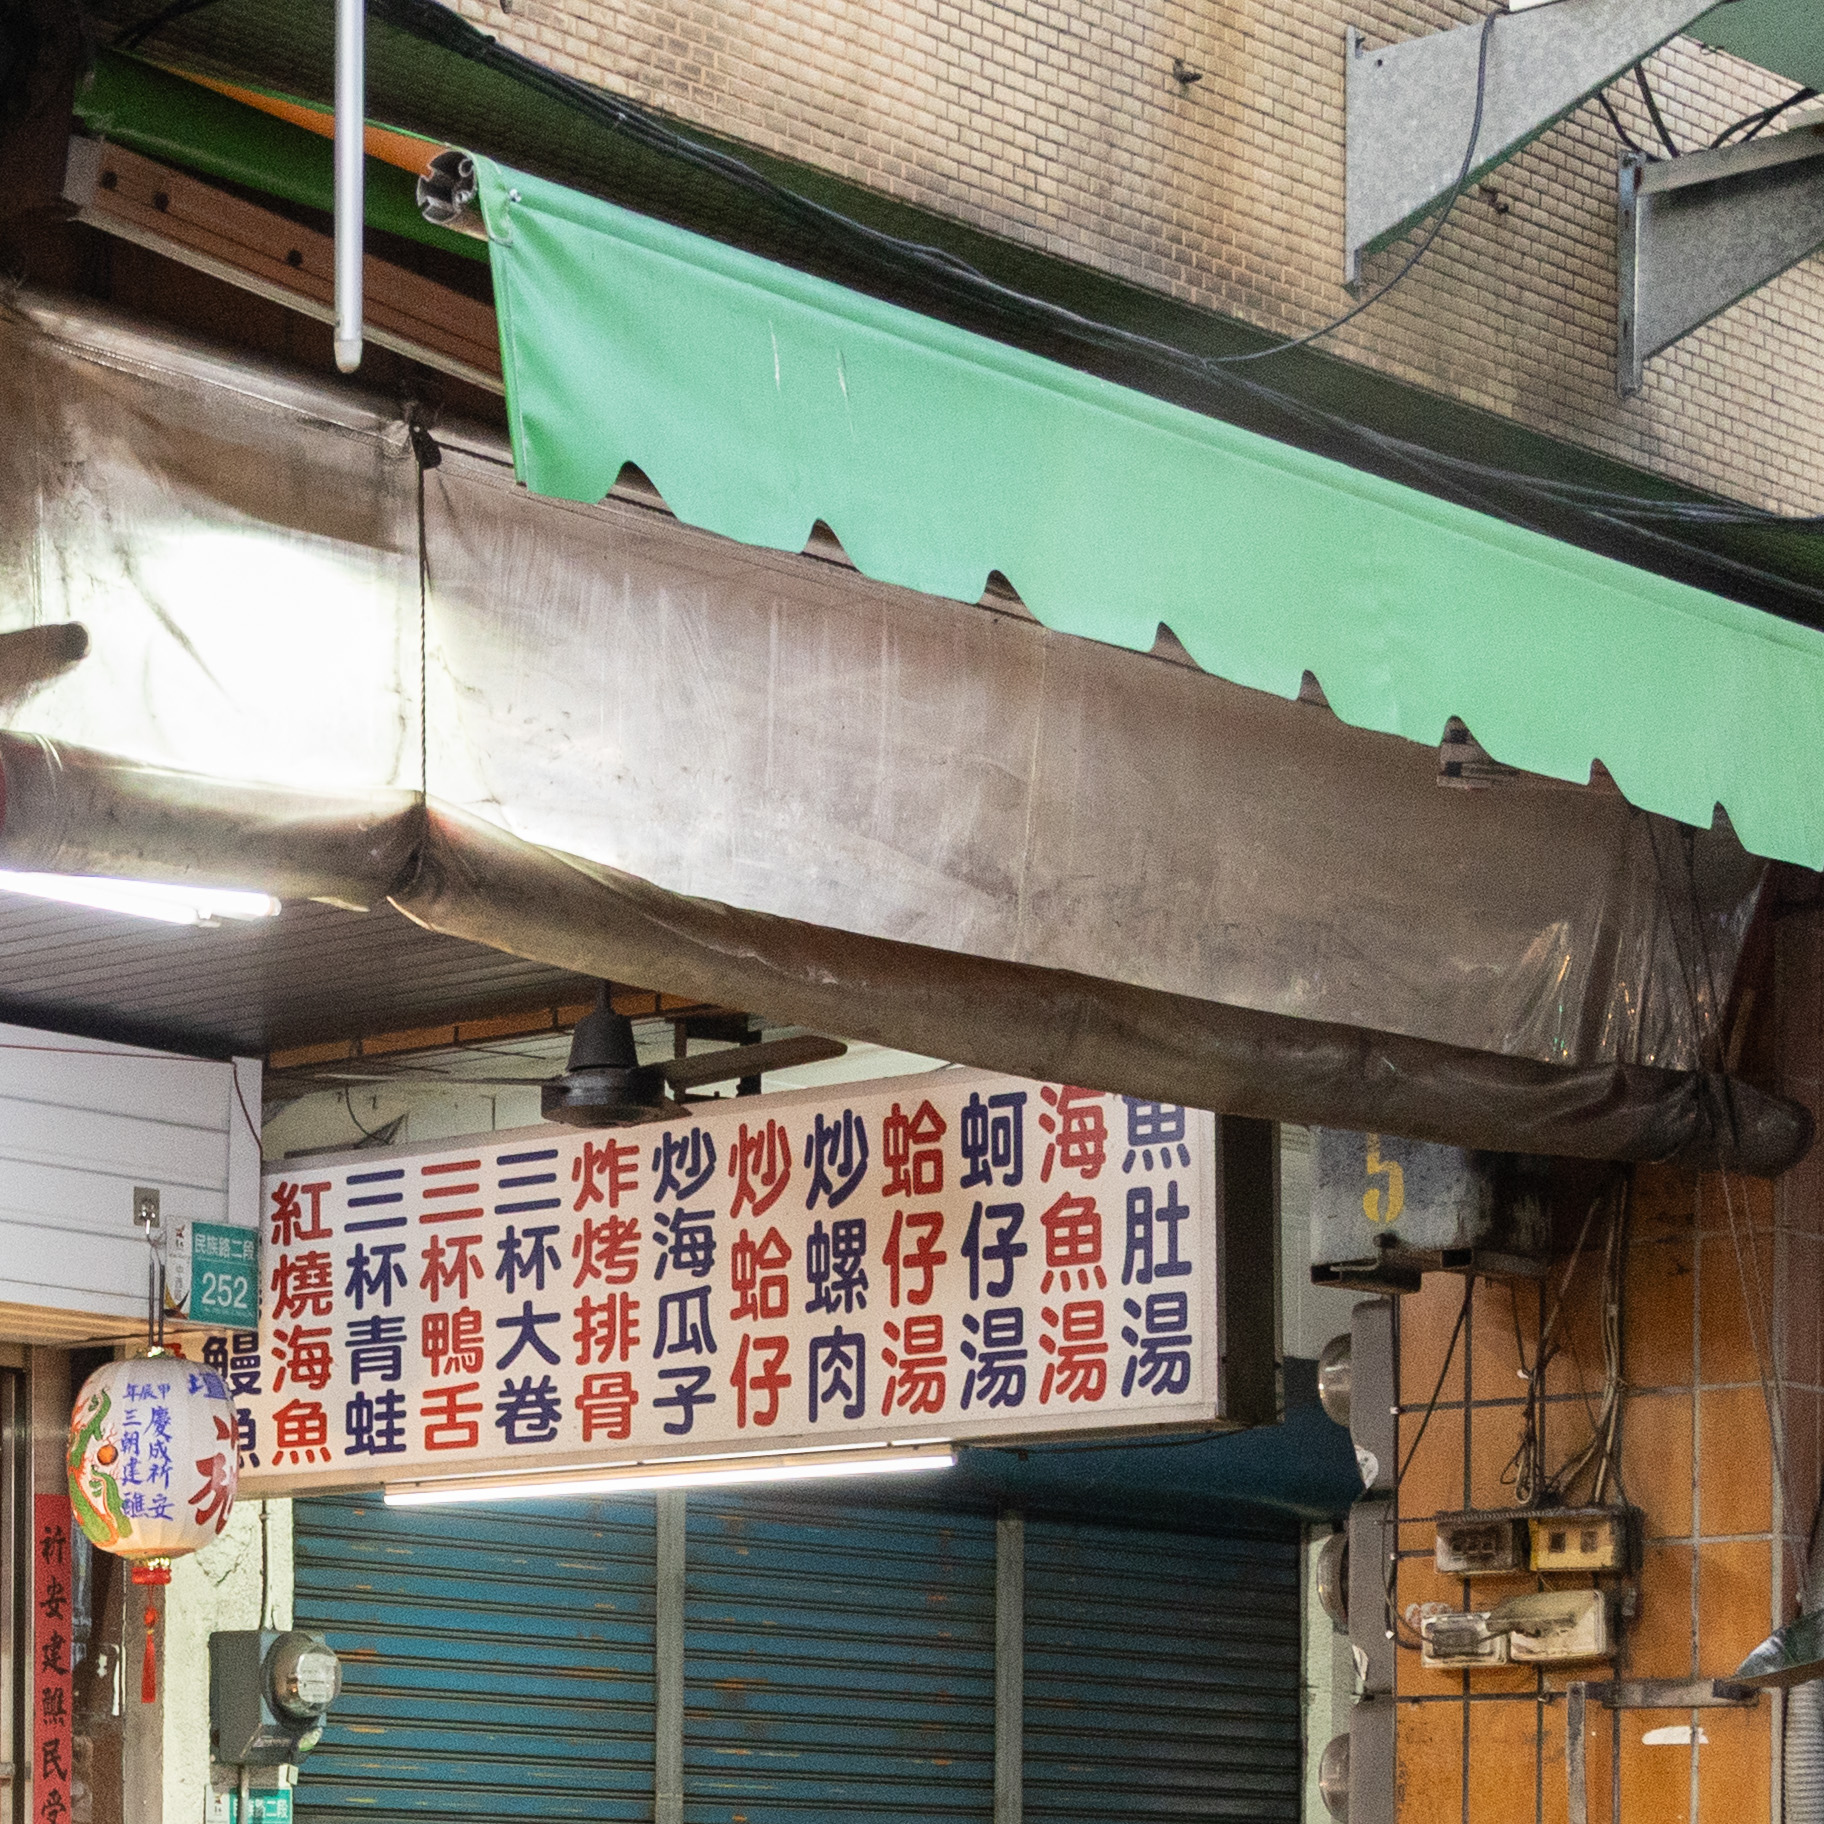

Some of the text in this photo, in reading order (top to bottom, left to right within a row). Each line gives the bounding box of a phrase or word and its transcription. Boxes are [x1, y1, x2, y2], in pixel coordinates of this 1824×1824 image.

[194, 1233, 255, 1261] 民族路二段
[201, 1271, 248, 1309] 252
[271, 1181, 333, 1466] 紅燒海魚
[344, 1169, 407, 1456] 三杯青蛙
[419, 1159, 485, 1451] 三杯鴨舌
[494, 1149, 562, 1446] 三杯大卷
[571, 1138, 642, 1442] 炸烤排骨
[652, 1126, 718, 1436] 炒海瓜子
[728, 1118, 792, 1429] 炒蛤仔
[804, 1109, 869, 1423] 炒螺肉
[881, 1099, 948, 1416] 蛤仔湯
[960, 1091, 1028, 1410] 蚵仔湯
[1038, 1085, 1109, 1405] 海魚湯
[1121, 1093, 1193, 1398] 魚肚湯
[233, 1798, 289, 1819] 路二段
